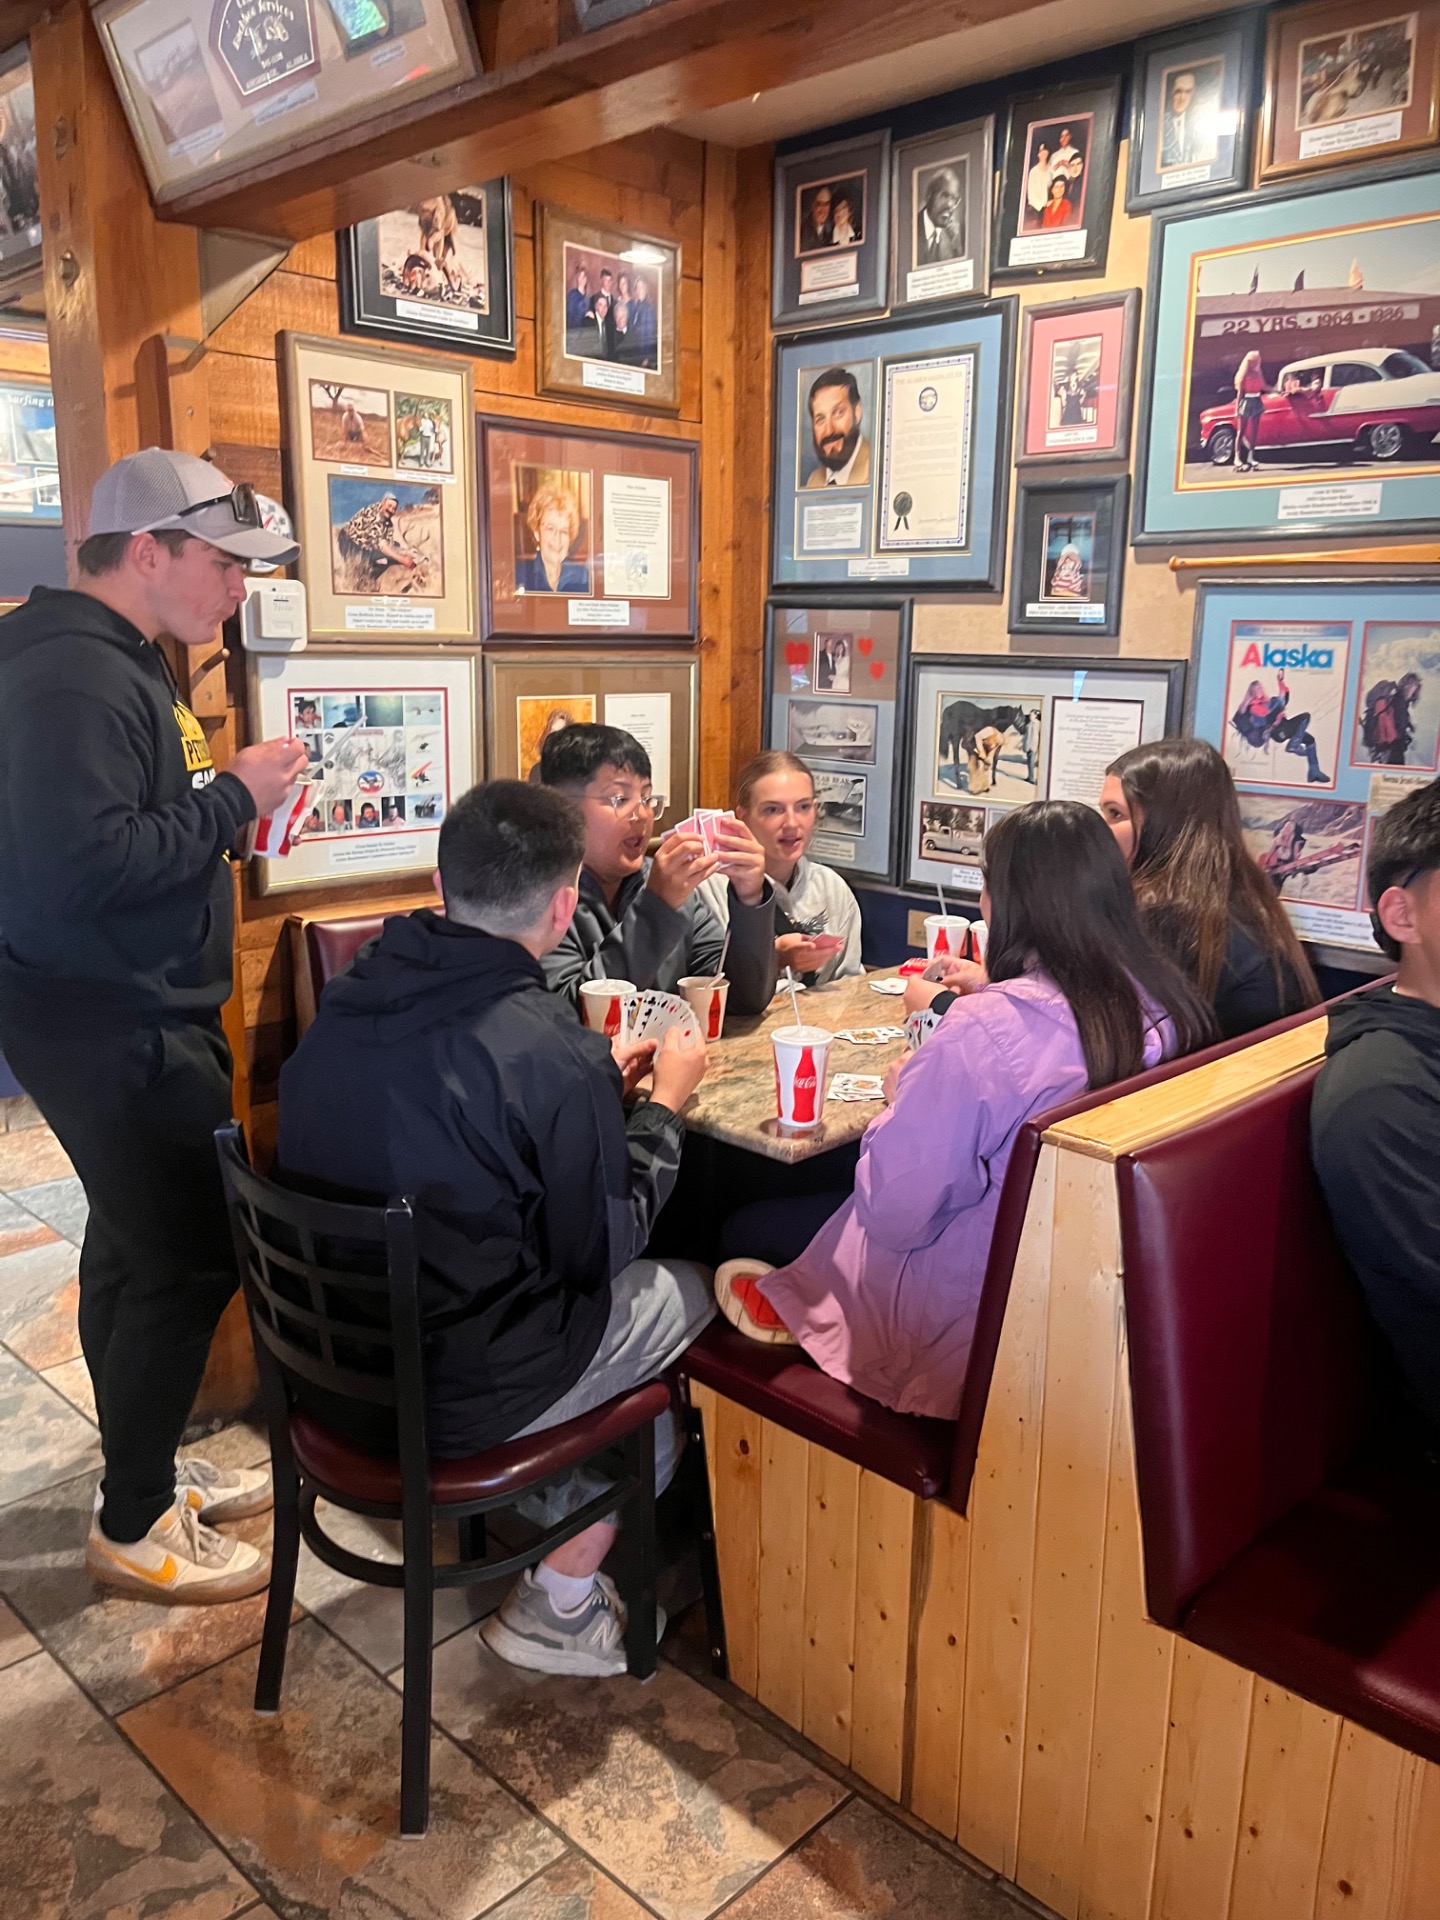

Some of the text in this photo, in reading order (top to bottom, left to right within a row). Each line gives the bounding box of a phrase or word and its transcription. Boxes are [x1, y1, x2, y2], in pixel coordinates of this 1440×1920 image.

[1223, 320, 1250, 336] 22
[1255, 316, 1298, 334] YRS
[1240, 642, 1335, 670] Alaska
